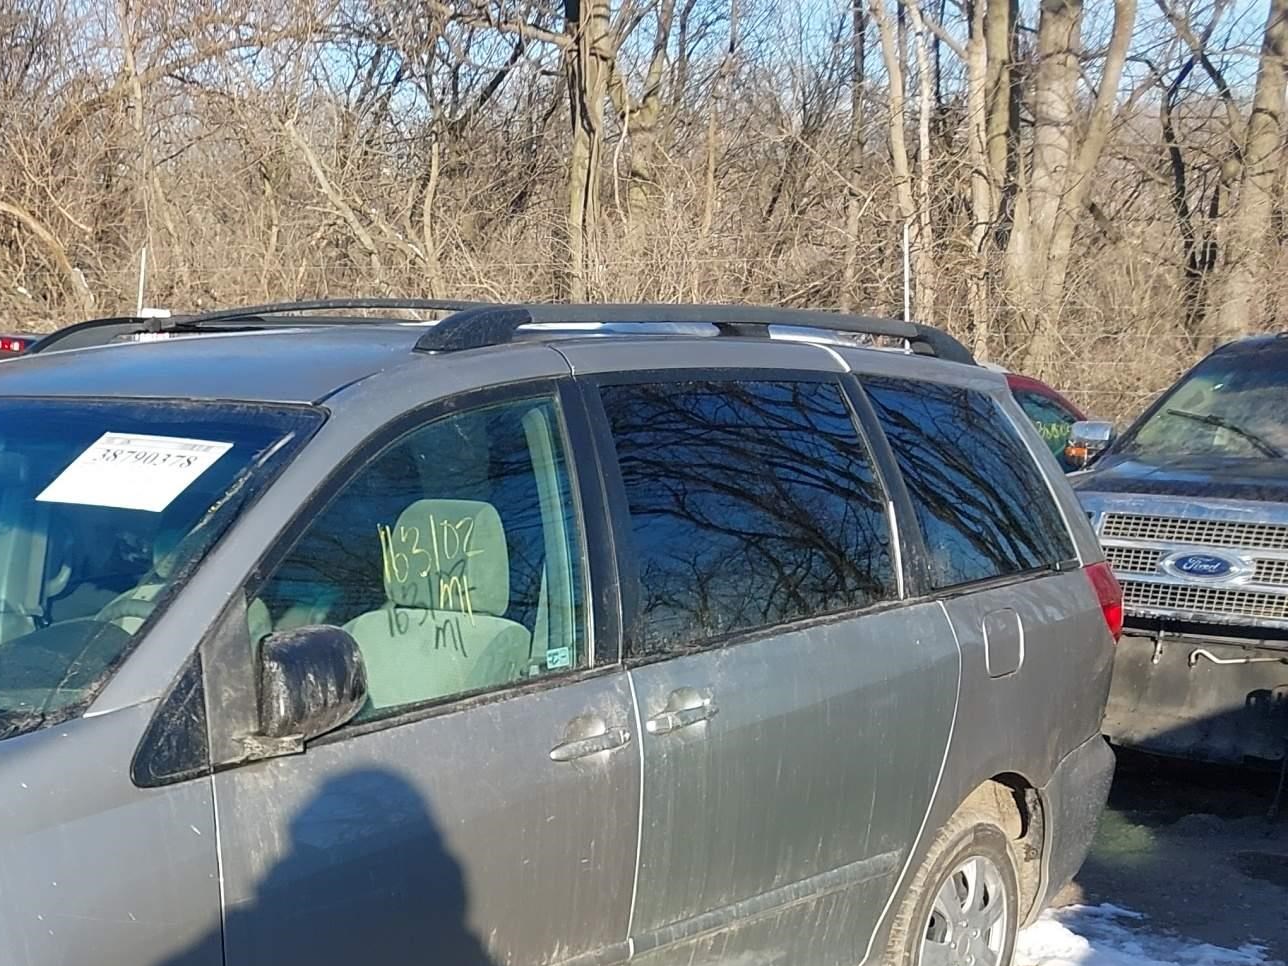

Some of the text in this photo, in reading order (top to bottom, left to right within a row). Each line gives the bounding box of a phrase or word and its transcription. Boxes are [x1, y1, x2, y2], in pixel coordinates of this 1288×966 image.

[93, 448, 199, 468] 38790378
[377, 515, 486, 584] 163102
[1182, 557, 1222, 571] Ford
